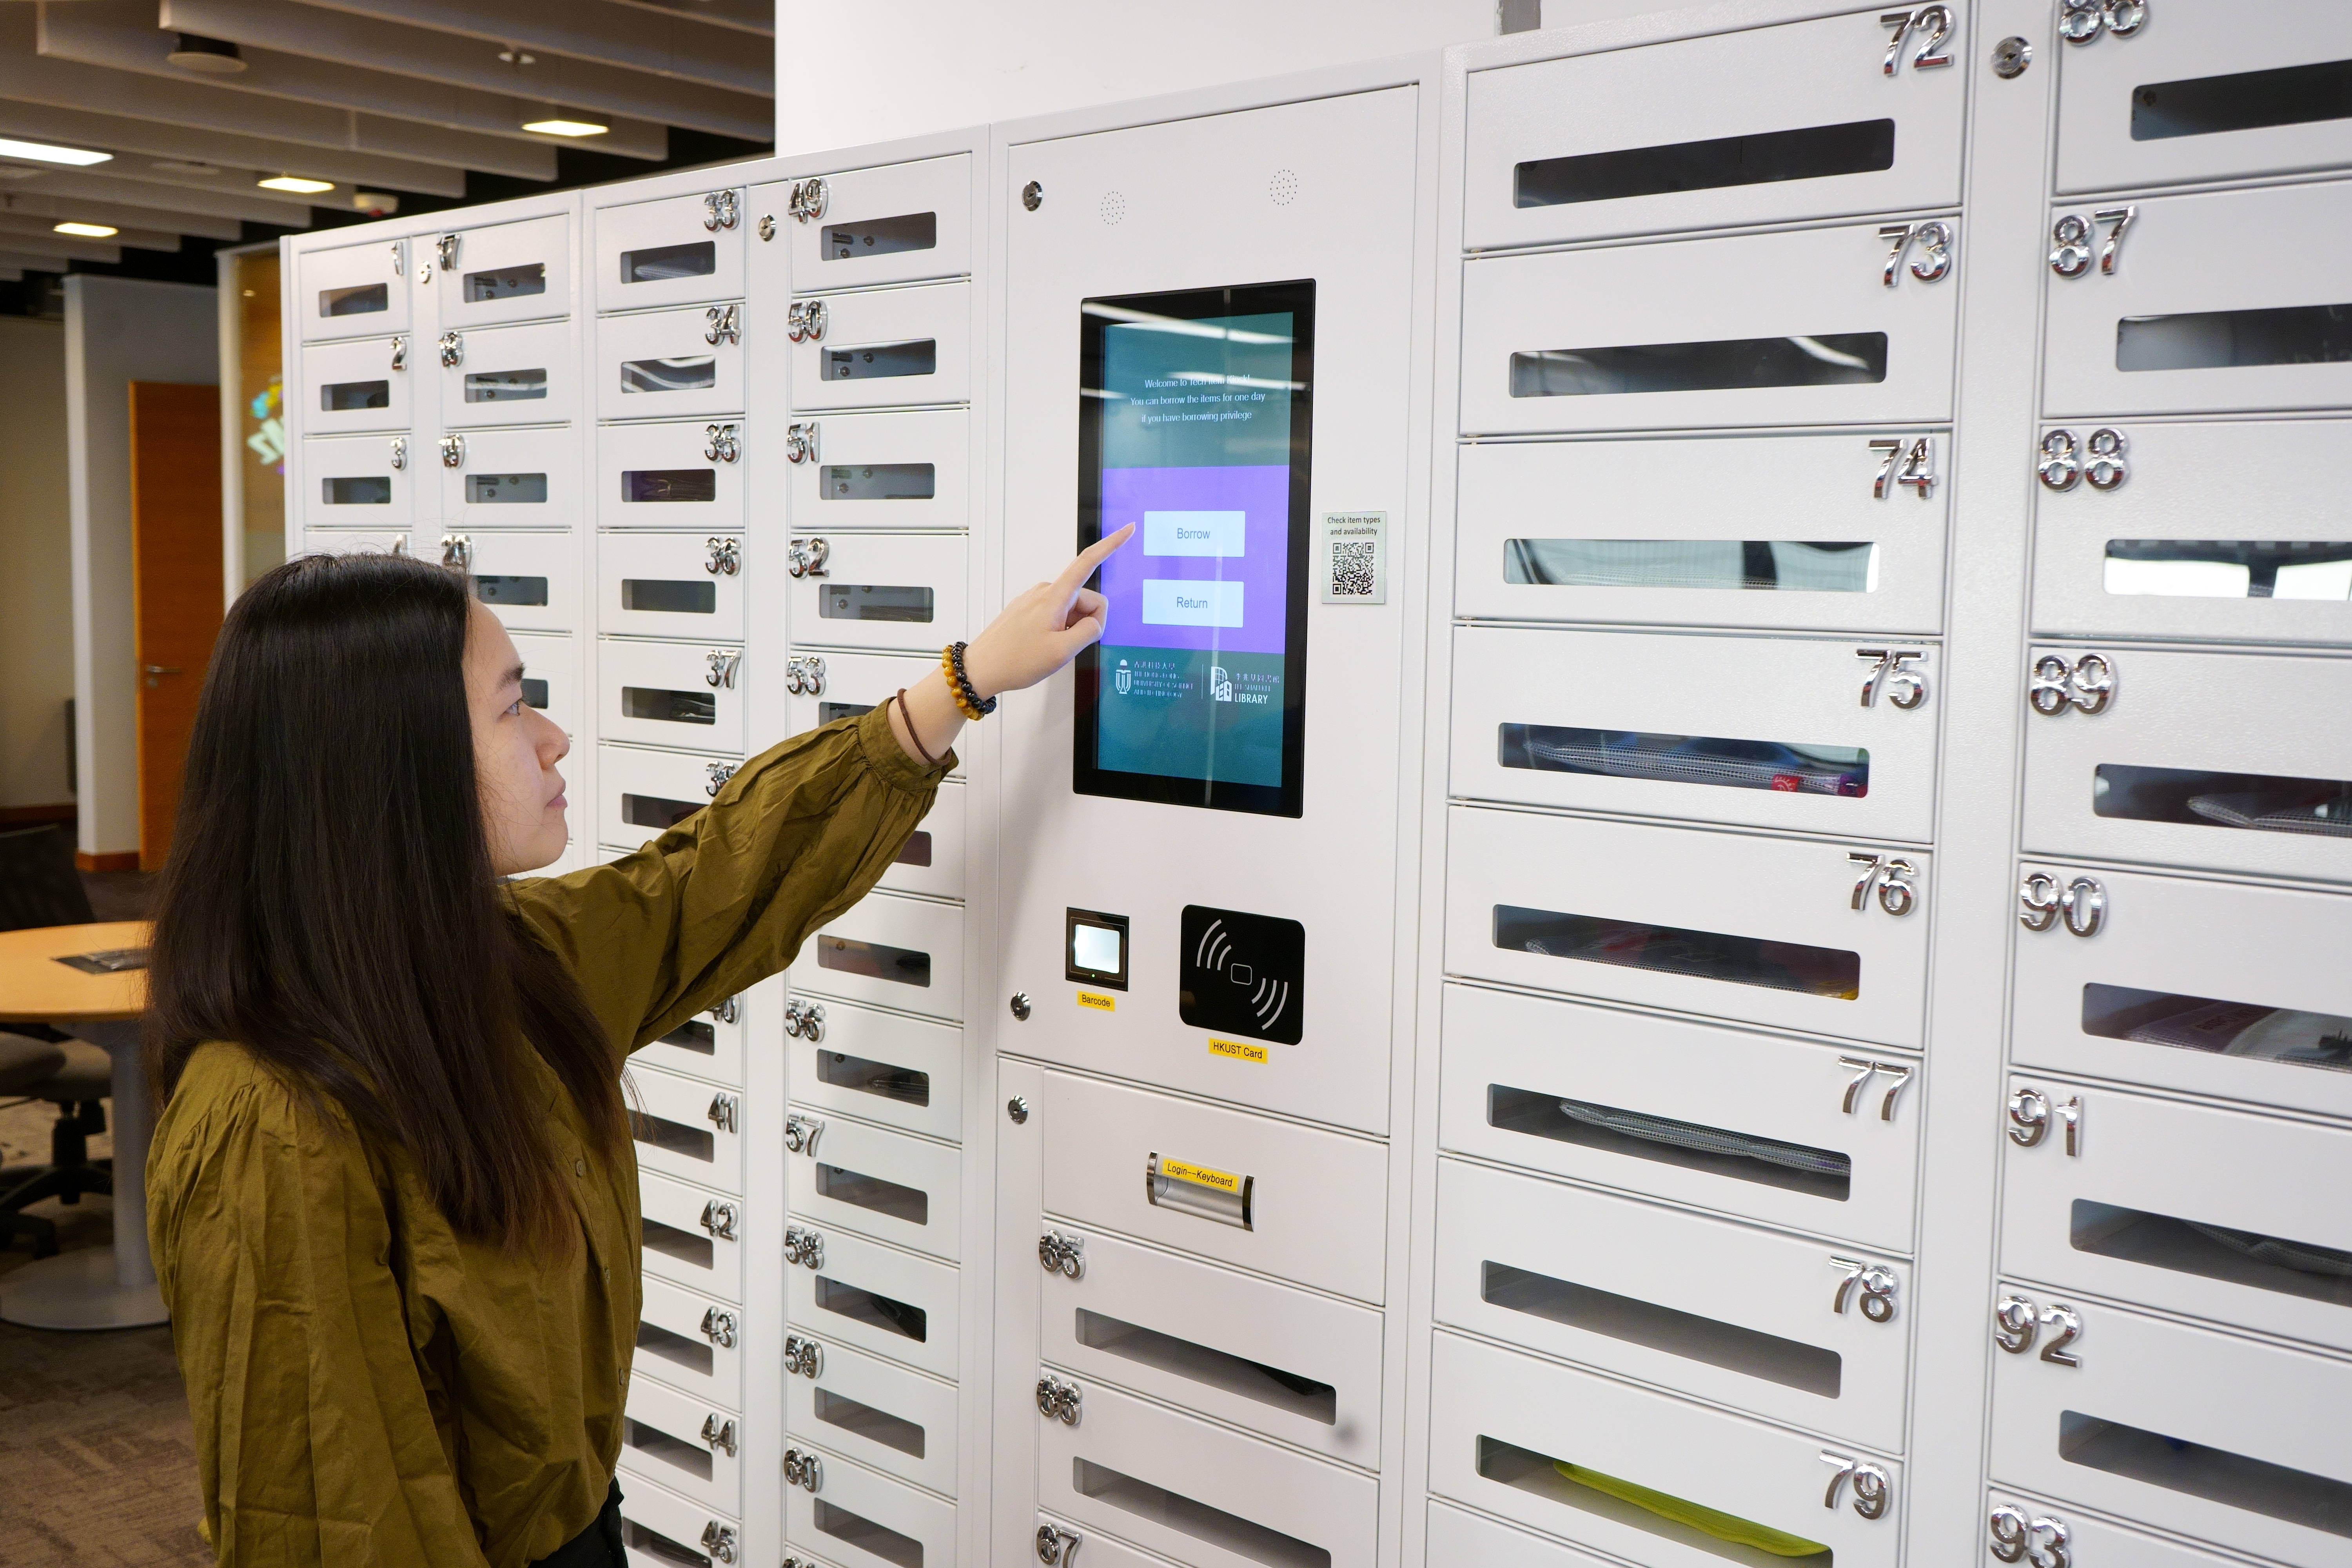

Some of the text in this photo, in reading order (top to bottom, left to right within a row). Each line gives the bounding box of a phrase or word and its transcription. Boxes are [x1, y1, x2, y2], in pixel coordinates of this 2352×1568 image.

[1880, 5, 1955, 76] 72
[704, 189, 740, 232] 33
[788, 177, 828, 223] 49
[391, 241, 403, 276] 1
[436, 234, 461, 271] 17
[1879, 222, 1951, 287] 73
[2049, 205, 2138, 279] 87
[706, 305, 741, 345] 34
[788, 299, 828, 343] 50
[389, 336, 407, 371] 2
[1131, 397, 1143, 406] You
[1161, 396, 1185, 405] borrow
[1187, 395, 1199, 403] the
[1201, 394, 1220, 403] items
[1223, 394, 1232, 402] for
[1251, 392, 1265, 402] day
[1145, 379, 1178, 388] Welcome
[1227, 374, 1250, 384] Kiosk!
[1142, 411, 1252, 424] if you have borrowing privilege
[390, 437, 407, 471] 3
[705, 423, 741, 463] 35
[788, 421, 820, 464] 51
[2038, 428, 2126, 492] 88
[1868, 438, 1938, 499] 74
[1177, 528, 1210, 539] Borrow
[706, 536, 741, 576] 36
[788, 537, 830, 579] 52
[1177, 597, 1208, 608] Return
[706, 650, 741, 690] 37
[787, 656, 826, 696] 53
[1855, 649, 1928, 710] 75
[2031, 653, 2116, 716] 89
[1235, 693, 1268, 704] LIBRARY
[1846, 852, 1918, 916] 76
[2019, 872, 2107, 937] 90
[786, 1000, 825, 1042] 56
[1082, 995, 1110, 1007] Barcode
[1213, 1042, 1262, 1059] HKUST Card
[1838, 1055, 1913, 1121] 77
[708, 1092, 738, 1134] 41
[2008, 1089, 2084, 1157] 91
[786, 1114, 825, 1157] 57
[700, 1199, 738, 1242] 42
[786, 1225, 823, 1270] 58
[1039, 1229, 1085, 1280] 65
[1829, 1255, 1897, 1323] 78
[701, 1306, 737, 1348] 43
[1995, 1296, 2082, 1368] 92
[786, 1335, 823, 1379] 59
[1037, 1375, 1083, 1426] 66
[701, 1412, 737, 1457] 44
[784, 1447, 822, 1493] 60
[1819, 1450, 1891, 1520] 79
[701, 1521, 738, 1565] 45
[1037, 1523, 1083, 1568] 67
[1990, 1504, 2072, 1568] 93
